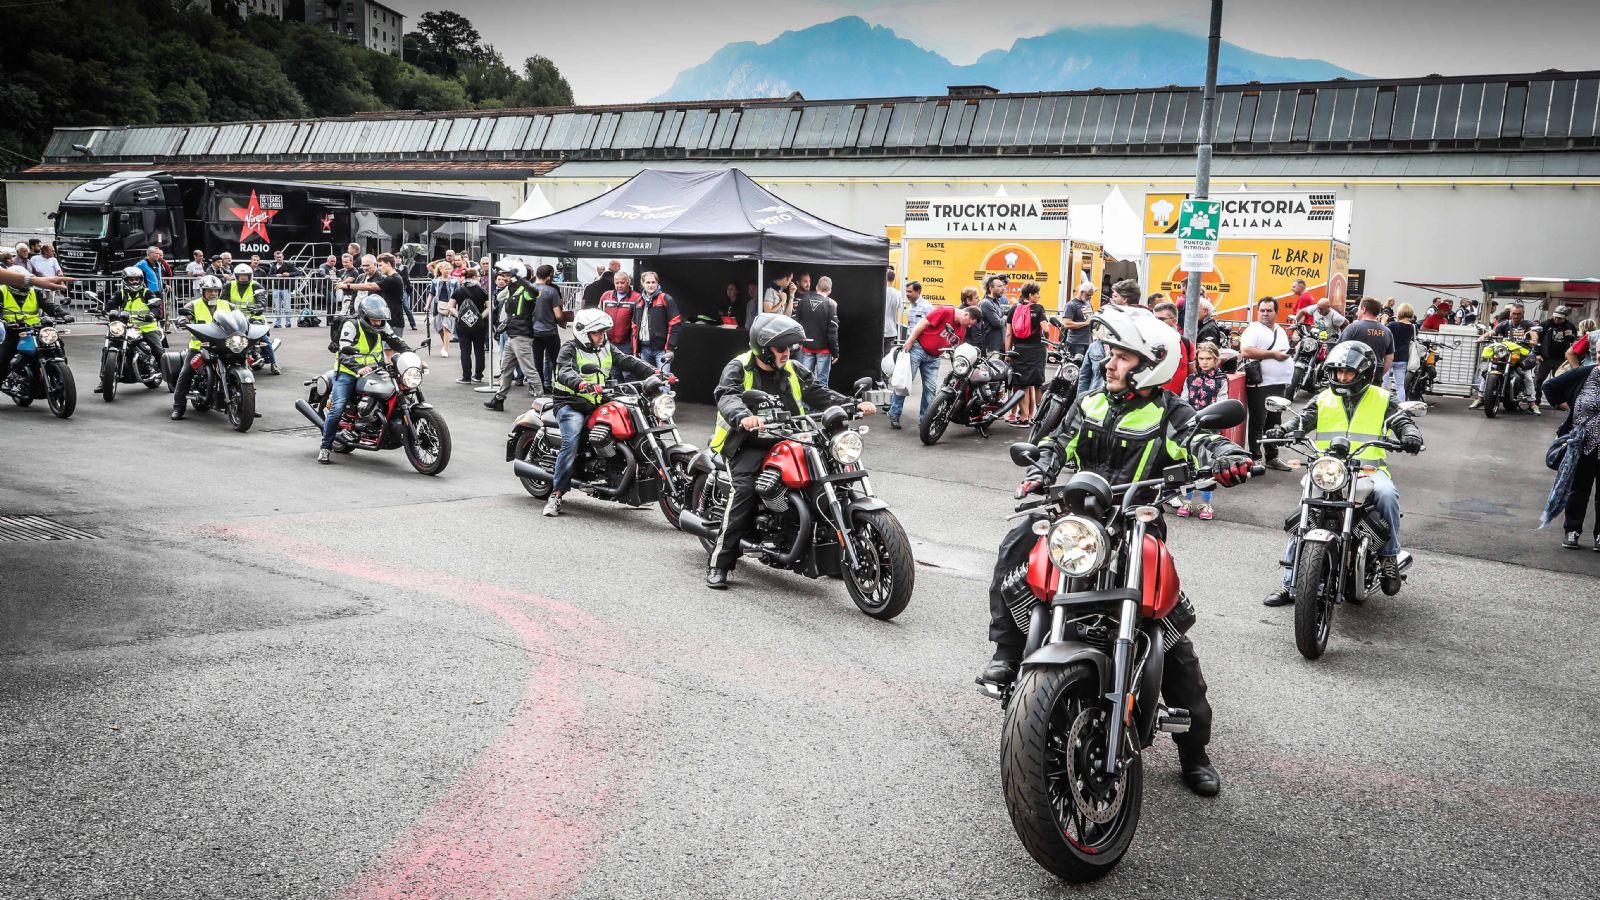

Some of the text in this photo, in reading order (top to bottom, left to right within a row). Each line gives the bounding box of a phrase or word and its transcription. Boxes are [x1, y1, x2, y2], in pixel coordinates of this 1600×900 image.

[933, 203, 1038, 218] TRUCKTORIA
[1221, 200, 1306, 214] CKTORIA
[245, 206, 269, 231] Virgin
[600, 209, 640, 219] MOTO
[757, 213, 792, 225] MOTO
[947, 222, 1017, 232] ITALIANA
[1221, 218, 1283, 228] ALIANA
[240, 243, 270, 252] RADIO
[601, 241, 652, 249] QUESTIONARI
[1272, 248, 1282, 260] IL
[1286, 248, 1309, 263] BAR
[1312, 252, 1323, 264] DI
[1269, 264, 1321, 279] TRUCKTORIA
[1367, 328, 1385, 337] STAFF
